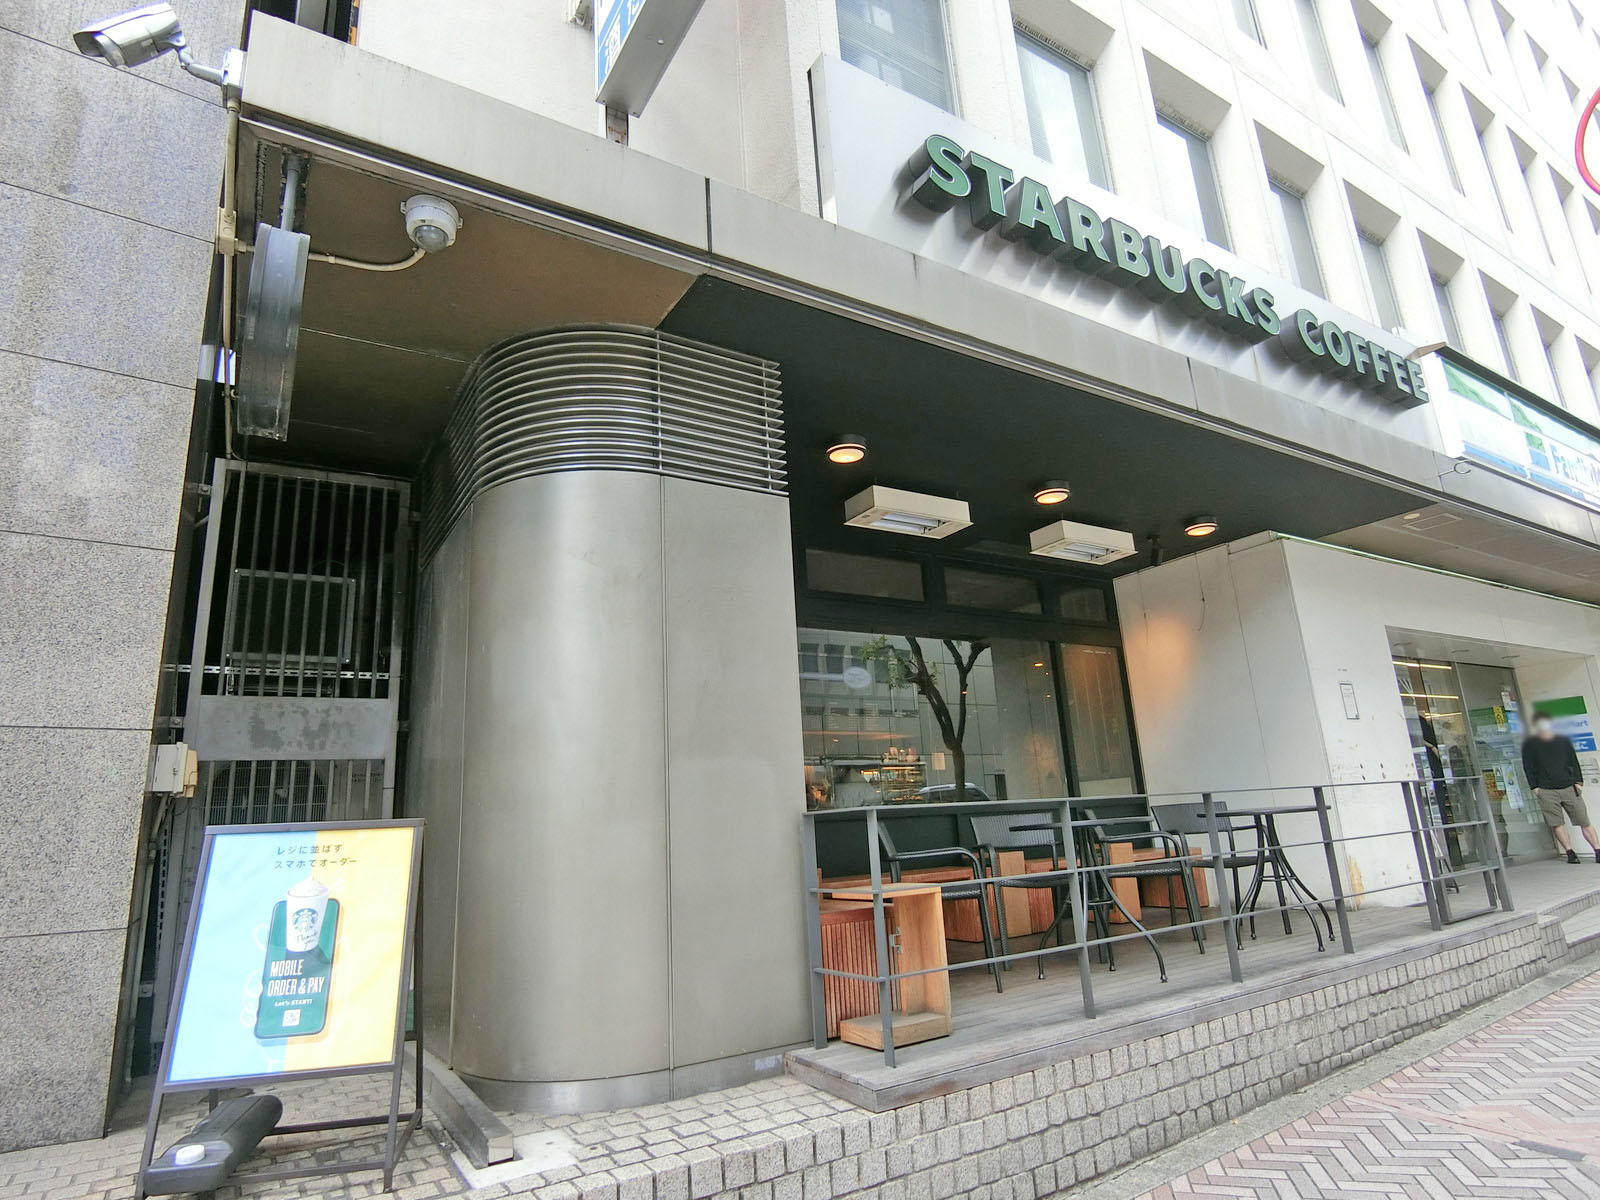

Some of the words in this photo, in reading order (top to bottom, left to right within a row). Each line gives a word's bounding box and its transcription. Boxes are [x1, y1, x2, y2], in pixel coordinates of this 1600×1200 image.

[925, 134, 1282, 336] STARBUCKS
[1297, 308, 1430, 404] COFFEE
[277, 844, 344, 856] レジに並ばず
[274, 857, 358, 869] スマホでオーダー
[270, 959, 304, 976] MOBILE
[267, 979, 298, 996] ORDER
[298, 977, 307, 995] &
[308, 976, 325, 993] PAY
